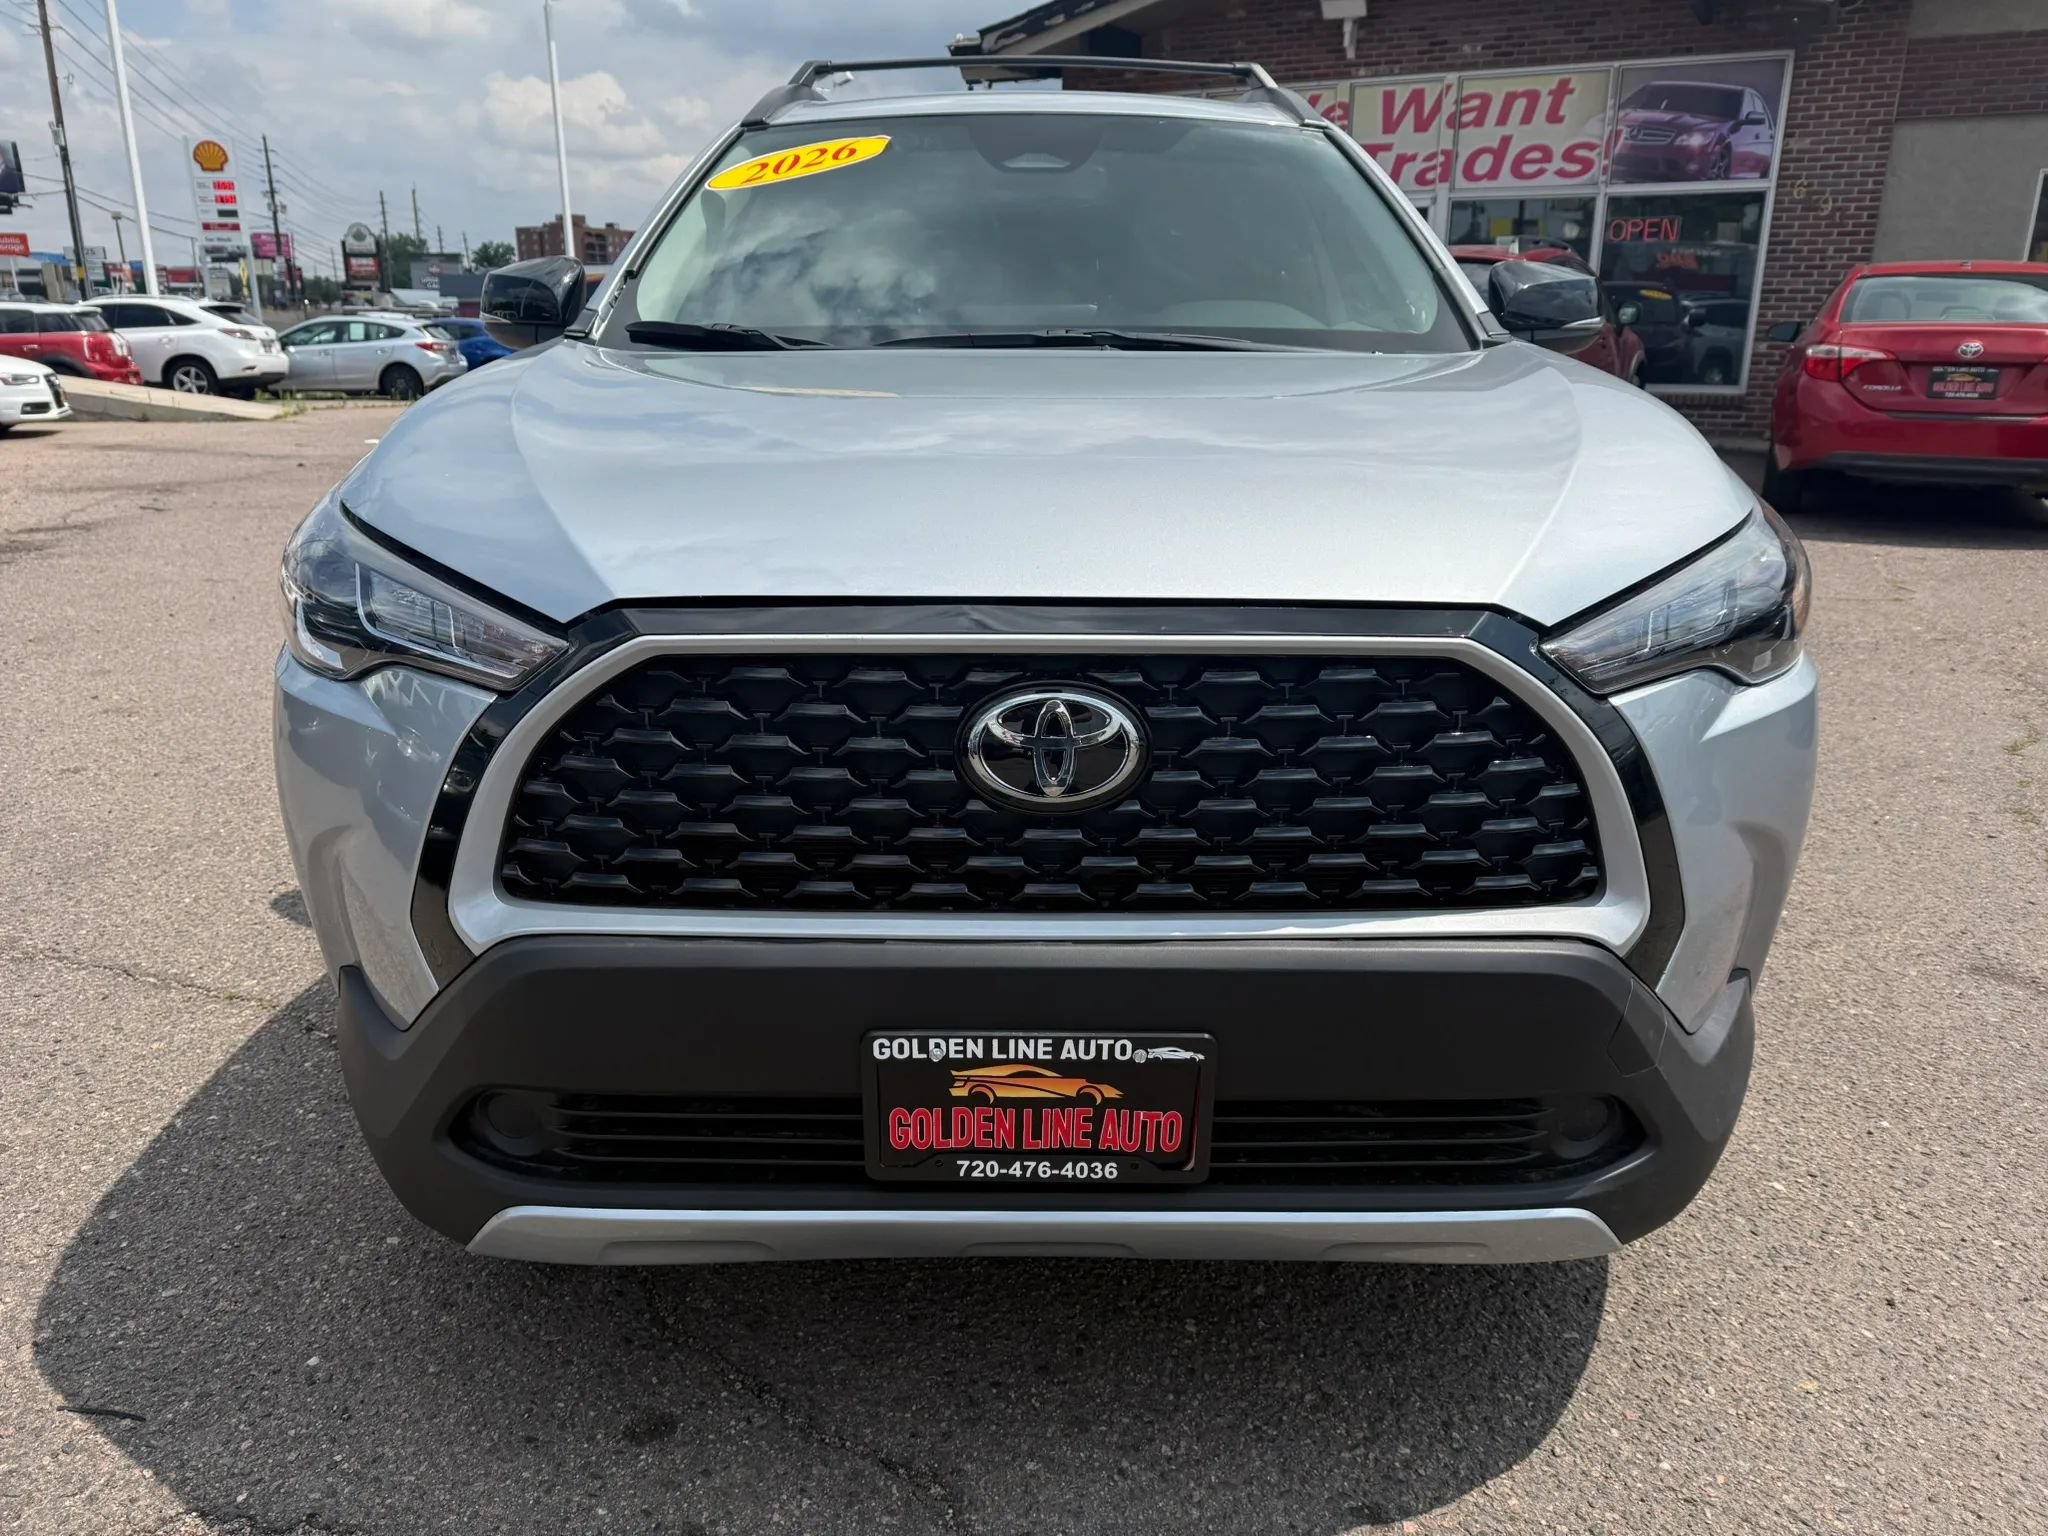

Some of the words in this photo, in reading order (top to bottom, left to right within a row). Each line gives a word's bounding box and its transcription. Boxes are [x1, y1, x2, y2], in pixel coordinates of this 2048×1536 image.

[1380, 77, 1574, 135] Want
[741, 139, 858, 184] 2026
[1361, 128, 1624, 188] Trades!
[1609, 218, 1681, 241] OPEN
[872, 1038, 984, 1061] GOLDEN
[992, 1038, 1053, 1060] LINE
[1060, 1039, 1133, 1061] AUTO
[888, 1107, 1015, 1150] GOLDEN
[1022, 1108, 1093, 1149] LINE
[1099, 1109, 1183, 1153] AUTO
[956, 1160, 1118, 1179] 720-476-4036
